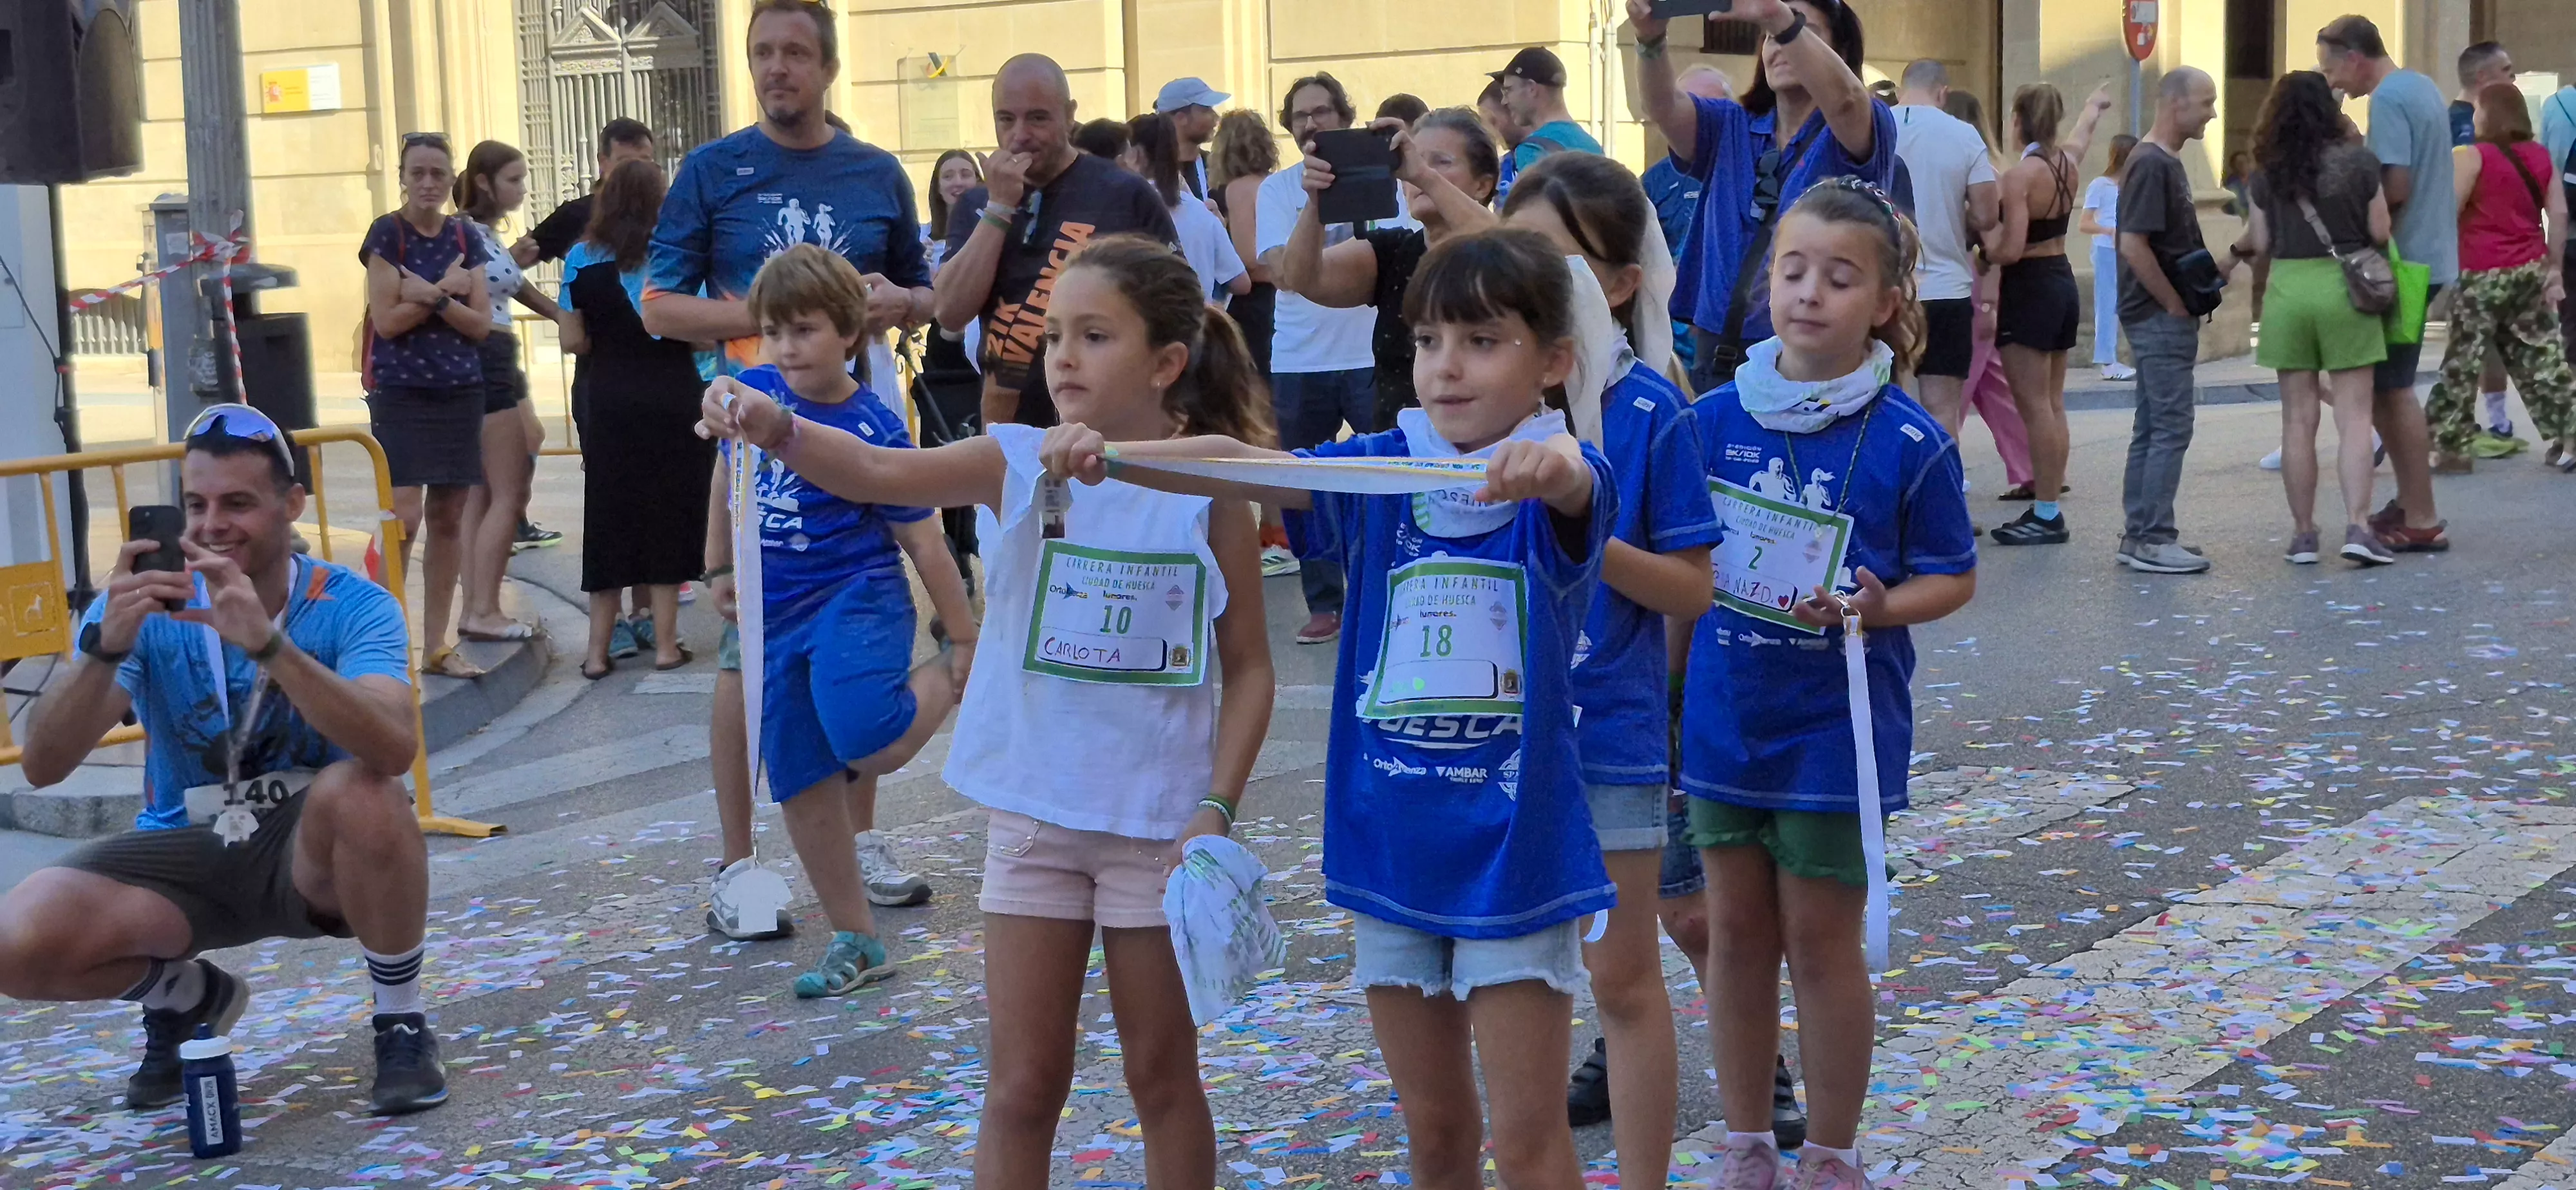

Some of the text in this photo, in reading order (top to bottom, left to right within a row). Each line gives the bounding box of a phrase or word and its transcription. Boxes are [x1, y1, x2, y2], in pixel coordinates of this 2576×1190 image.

[1723, 497, 1814, 531] CARRERA INFANTI
[1758, 522, 1767, 533] DE
[1066, 556, 1179, 578] CARRERA INFANTIL
[1748, 545, 1763, 570] 2
[1082, 576, 1156, 590] CIUDAD DE HUESCA
[1434, 576, 1499, 592] INFANTIL
[1427, 594, 1439, 606] DE
[1442, 594, 1477, 607] HUESCA
[1099, 605, 1132, 635] 10
[1044, 636, 1121, 663] CARLOTA
[1419, 625, 1453, 658] 18
[1362, 714, 1522, 739] UESCA
[1445, 766, 1488, 779] AMBAR
[223, 779, 290, 806] 140
